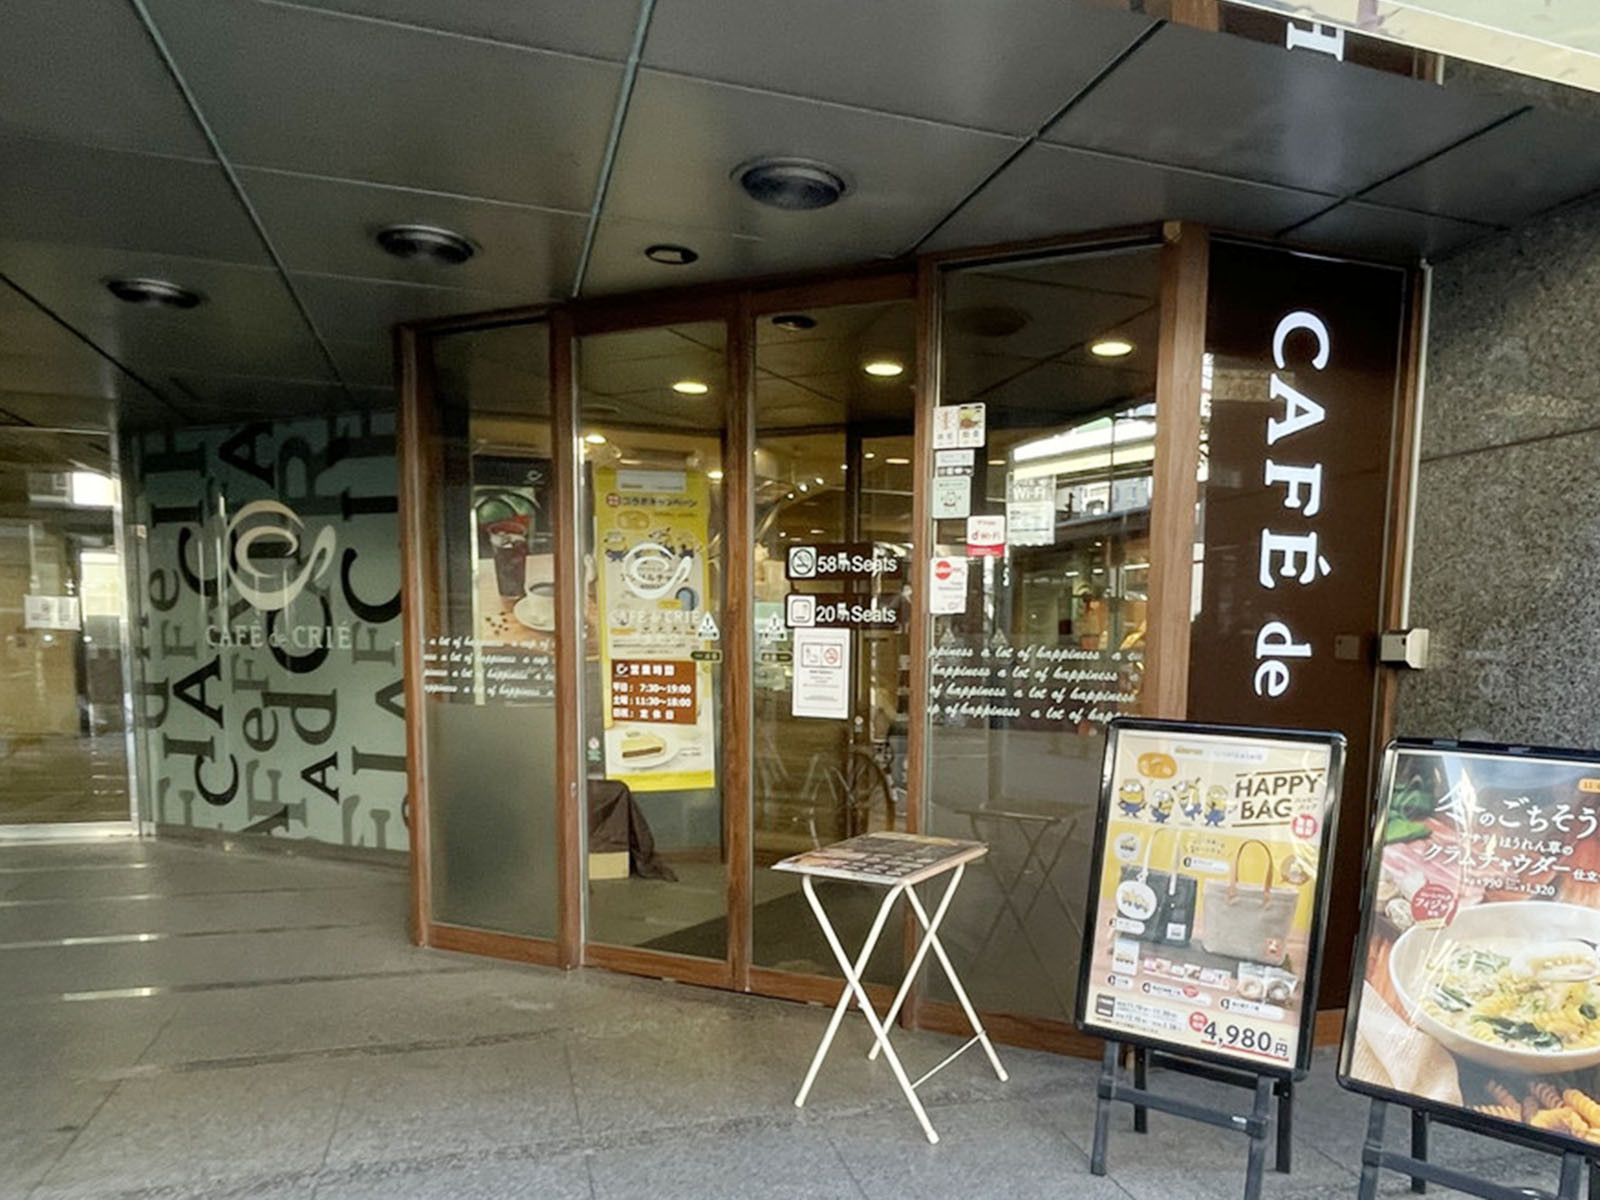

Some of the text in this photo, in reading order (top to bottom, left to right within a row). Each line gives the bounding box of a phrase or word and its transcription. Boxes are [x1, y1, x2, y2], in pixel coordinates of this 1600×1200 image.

[1254, 310, 1332, 698] CAFÉ de
[817, 555, 898, 574] 58 Seats
[815, 604, 897, 623] 20 Seats
[1235, 773, 1324, 799] HAPPY
[1240, 798, 1293, 821] BAG
